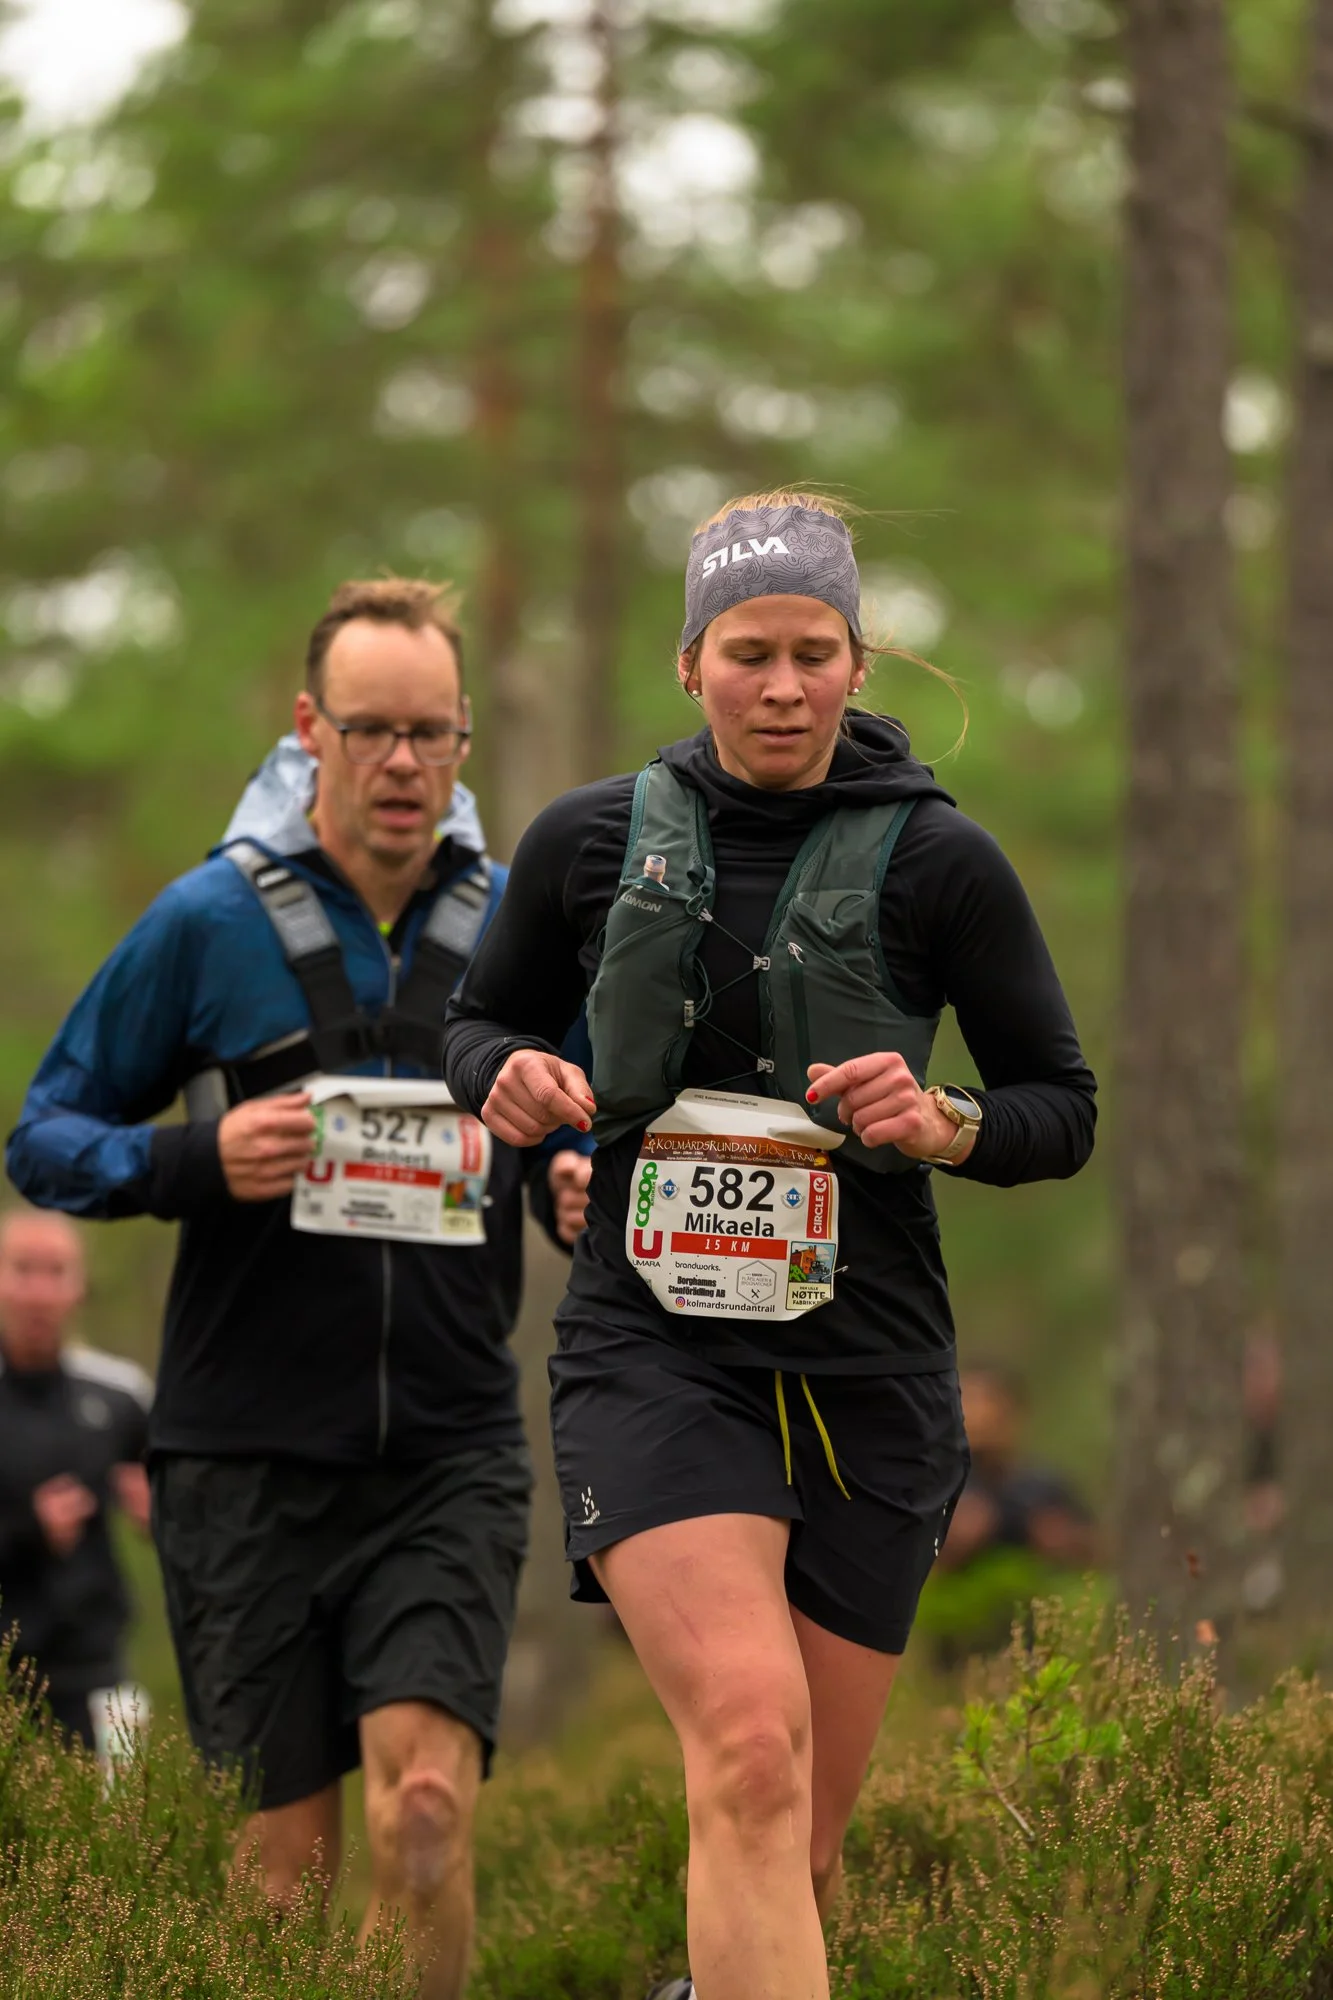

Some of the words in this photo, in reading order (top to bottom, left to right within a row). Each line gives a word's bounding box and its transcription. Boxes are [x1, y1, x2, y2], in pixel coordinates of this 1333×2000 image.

[702, 536, 790, 579] SILVA
[361, 1108, 430, 1145] 527
[635, 1161, 658, 1227] coop
[689, 1166, 775, 1212] 582
[815, 1178, 827, 1191] K
[685, 1212, 775, 1237] Mikaela
[813, 1195, 824, 1234] CIRCLE
[705, 1238, 720, 1250] 15
[731, 1240, 750, 1252] KM
[677, 1275, 717, 1287] Borghamns
[715, 1289, 726, 1298] AB
[686, 1299, 775, 1312] kolmardsrundantrail
